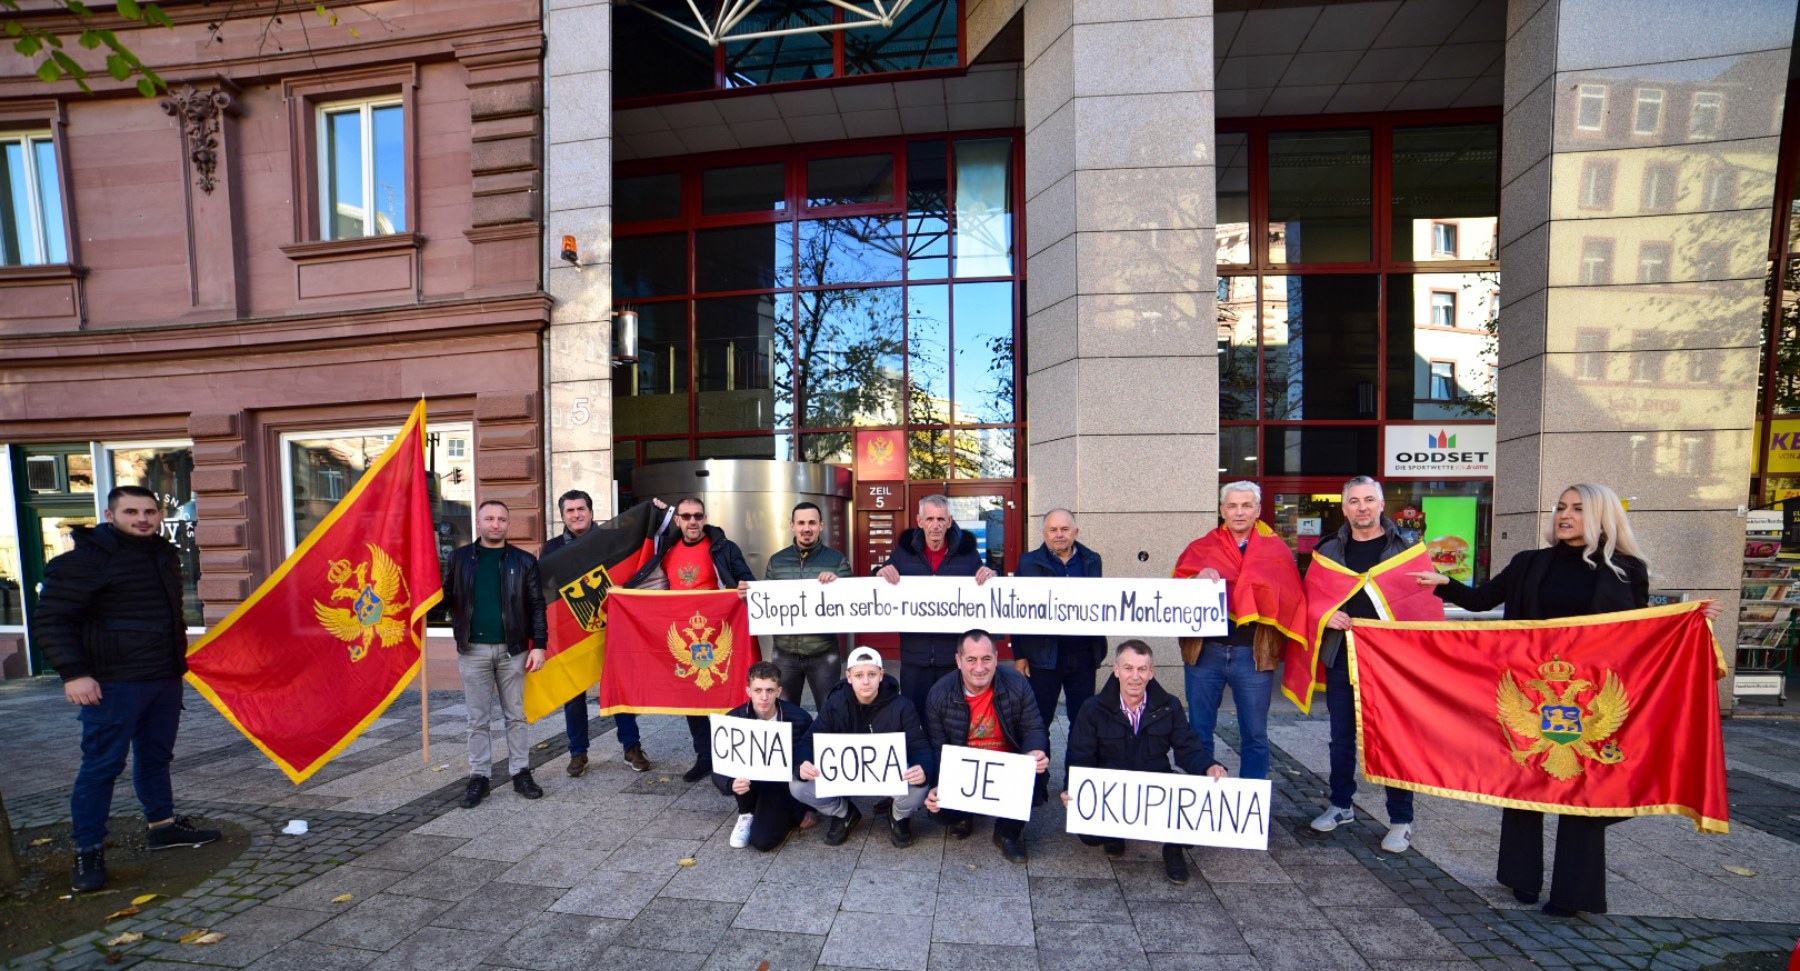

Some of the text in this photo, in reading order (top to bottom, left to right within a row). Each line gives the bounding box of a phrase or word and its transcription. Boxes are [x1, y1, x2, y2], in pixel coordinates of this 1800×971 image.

[571, 398, 590, 426] 5
[1396, 452, 1489, 463] ODDSET
[869, 487, 892, 496] ZEIL
[875, 496, 885, 508] 5
[164, 493, 195, 538] SNACKS
[750, 590, 807, 627] Stoppt
[815, 591, 844, 617] den
[990, 587, 1099, 622] Nationalismus
[1101, 603, 1117, 622] in
[1120, 590, 1226, 632] Montenegro!
[713, 725, 788, 767] CRNA
[820, 745, 905, 782] GORA
[960, 758, 1005, 801] JE
[1077, 778, 1264, 835] OKUPIRANA
